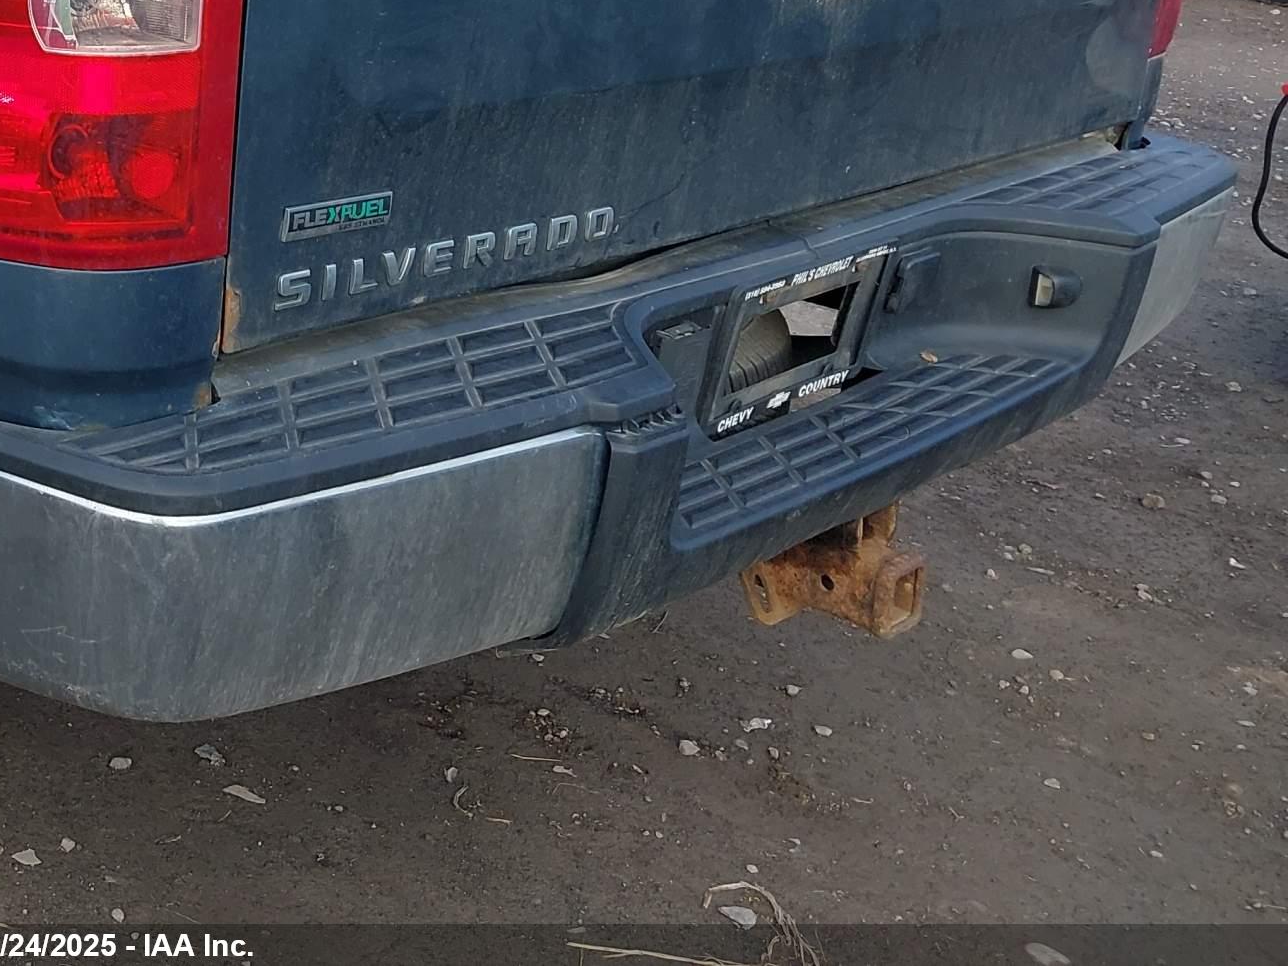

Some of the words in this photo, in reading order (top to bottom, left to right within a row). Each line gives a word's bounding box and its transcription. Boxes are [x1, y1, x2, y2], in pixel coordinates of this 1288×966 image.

[273, 206, 616, 312] SILVERADO
[716, 407, 755, 434] CHEVY
[798, 369, 850, 398] COUNTRY
